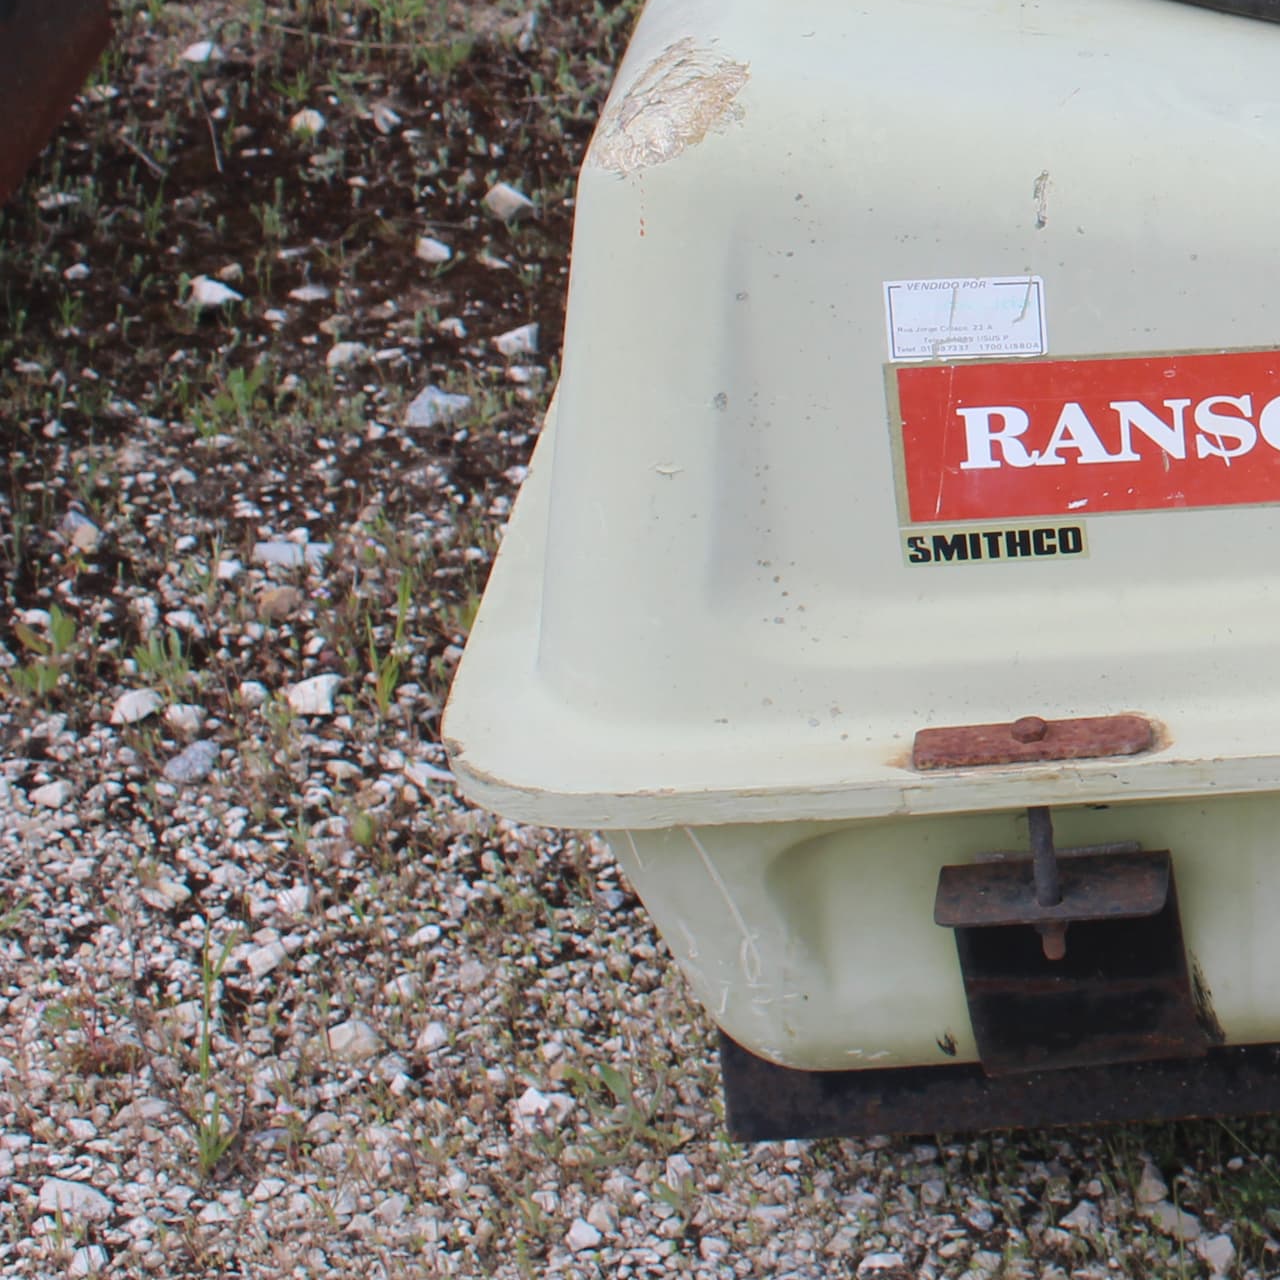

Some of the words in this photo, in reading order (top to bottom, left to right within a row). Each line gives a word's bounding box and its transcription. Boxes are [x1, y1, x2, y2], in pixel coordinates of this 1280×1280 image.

[906, 281, 960, 290] VENDIDO
[1004, 342, 1040, 350] LISBOA
[907, 527, 1083, 564] SMITHCO
